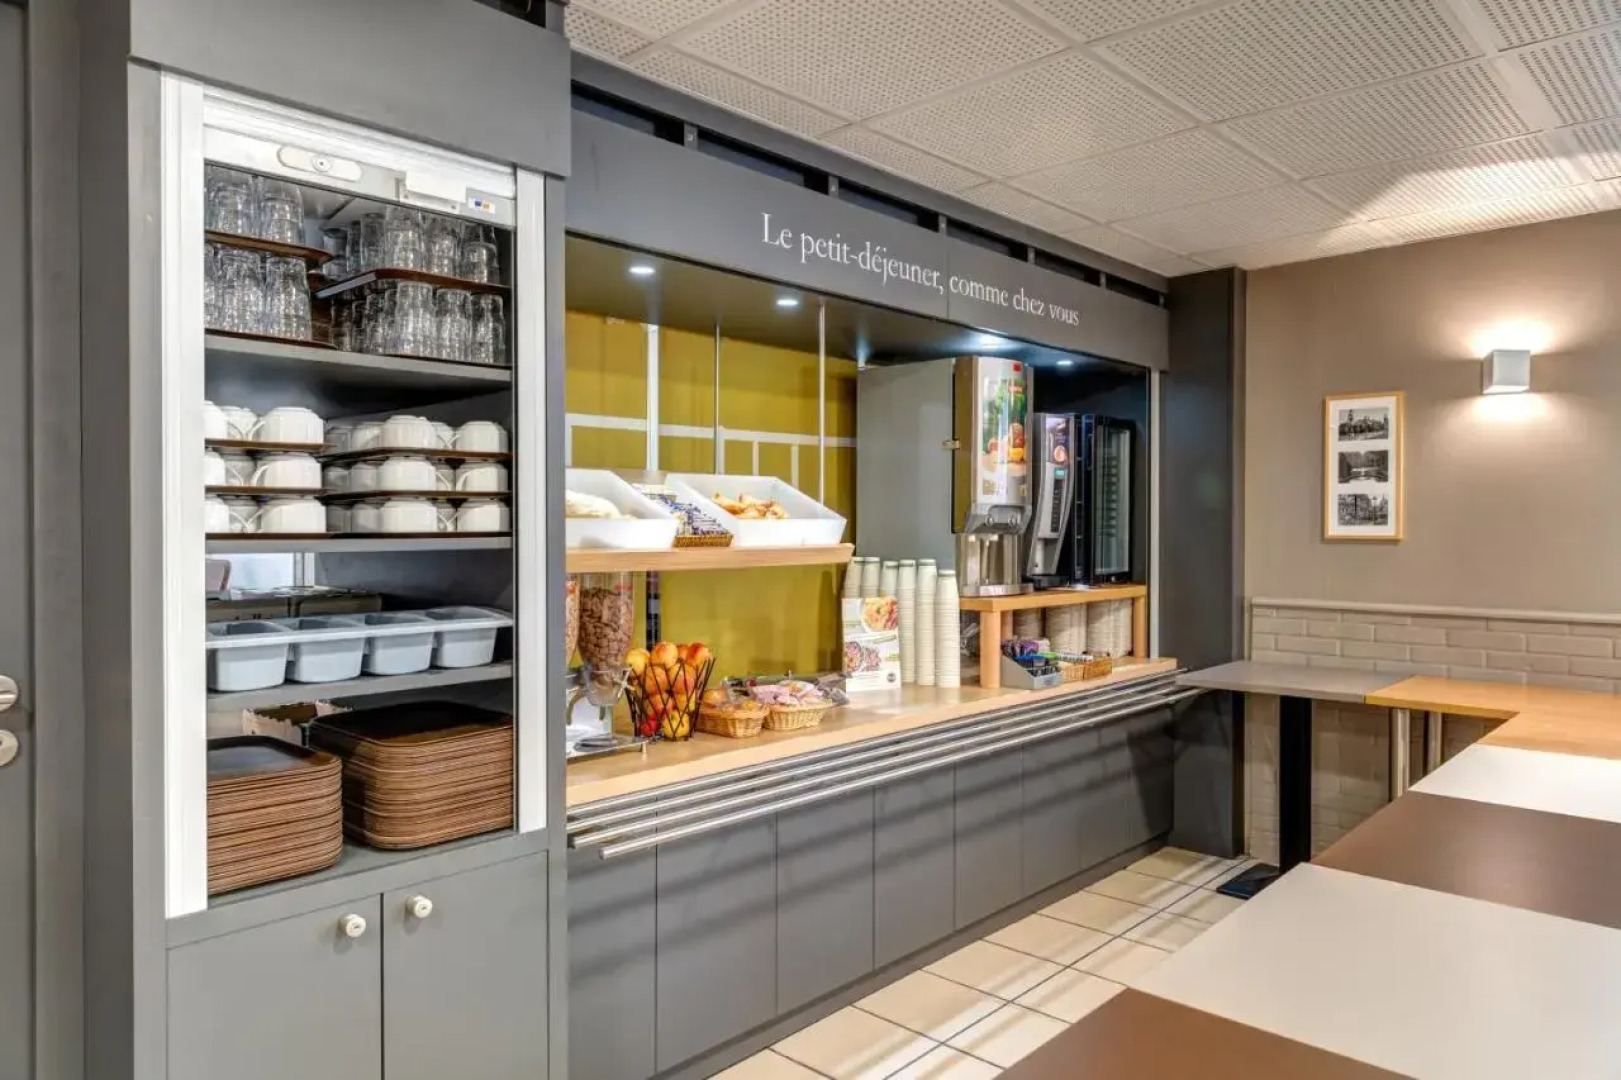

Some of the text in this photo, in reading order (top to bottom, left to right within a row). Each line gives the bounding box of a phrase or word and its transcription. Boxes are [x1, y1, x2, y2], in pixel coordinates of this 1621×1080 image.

[762, 212, 1080, 326] Le petit-déjeuner, comme chez vous
